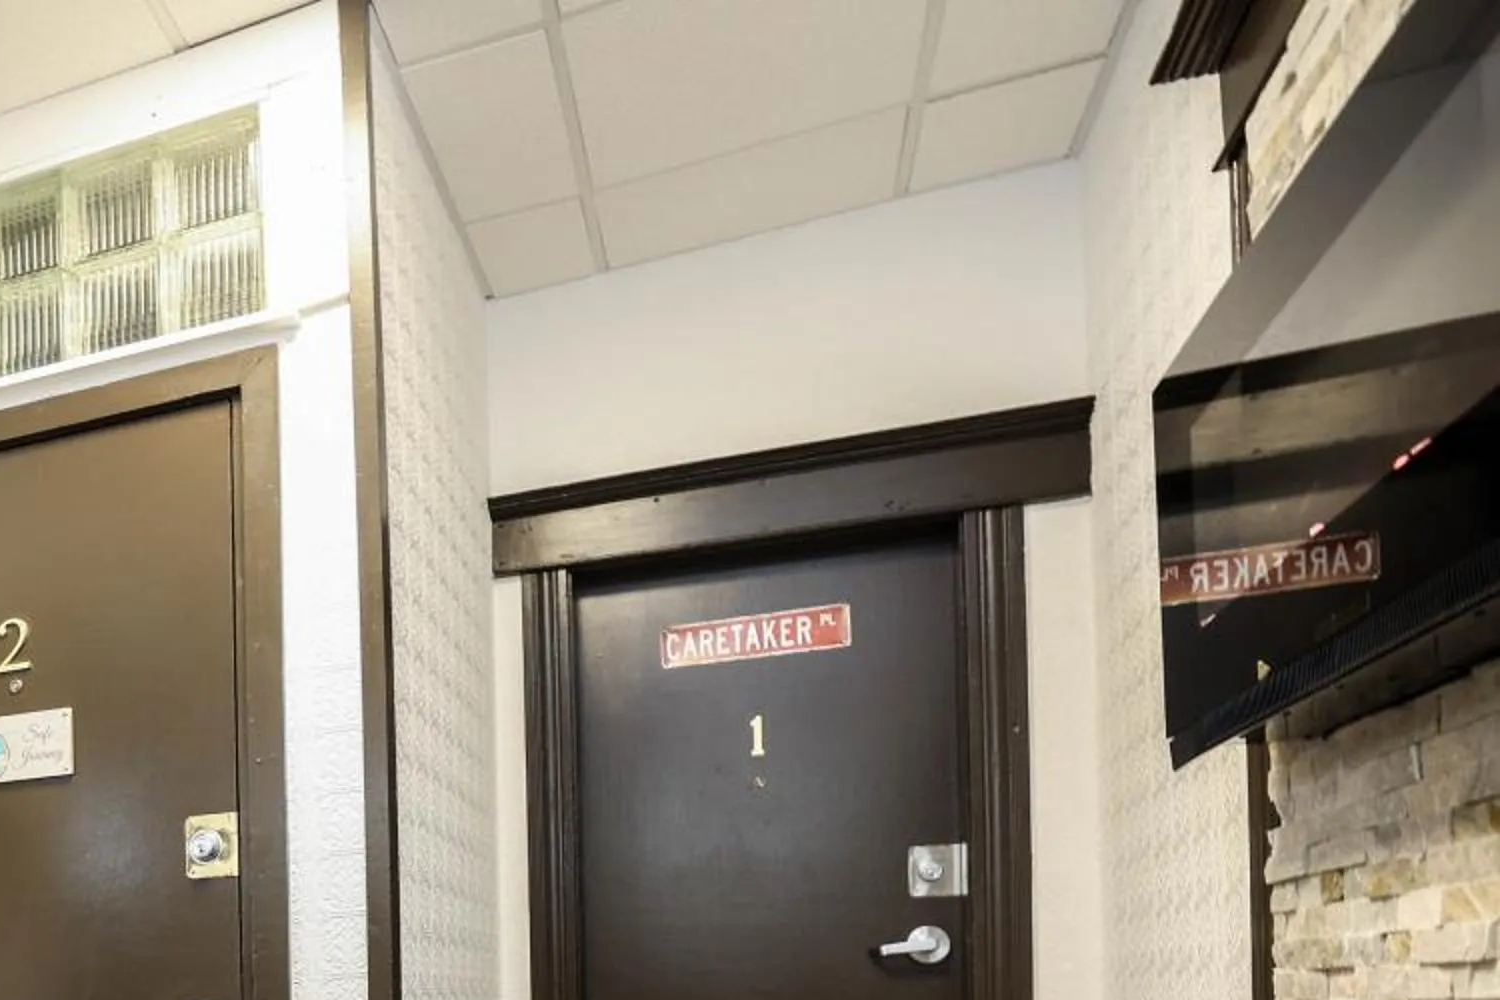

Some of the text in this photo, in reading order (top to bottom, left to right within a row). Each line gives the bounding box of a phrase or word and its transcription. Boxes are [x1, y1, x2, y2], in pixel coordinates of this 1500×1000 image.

[665, 612, 836, 661] CARETAKER PL
[749, 714, 766, 757] 1
